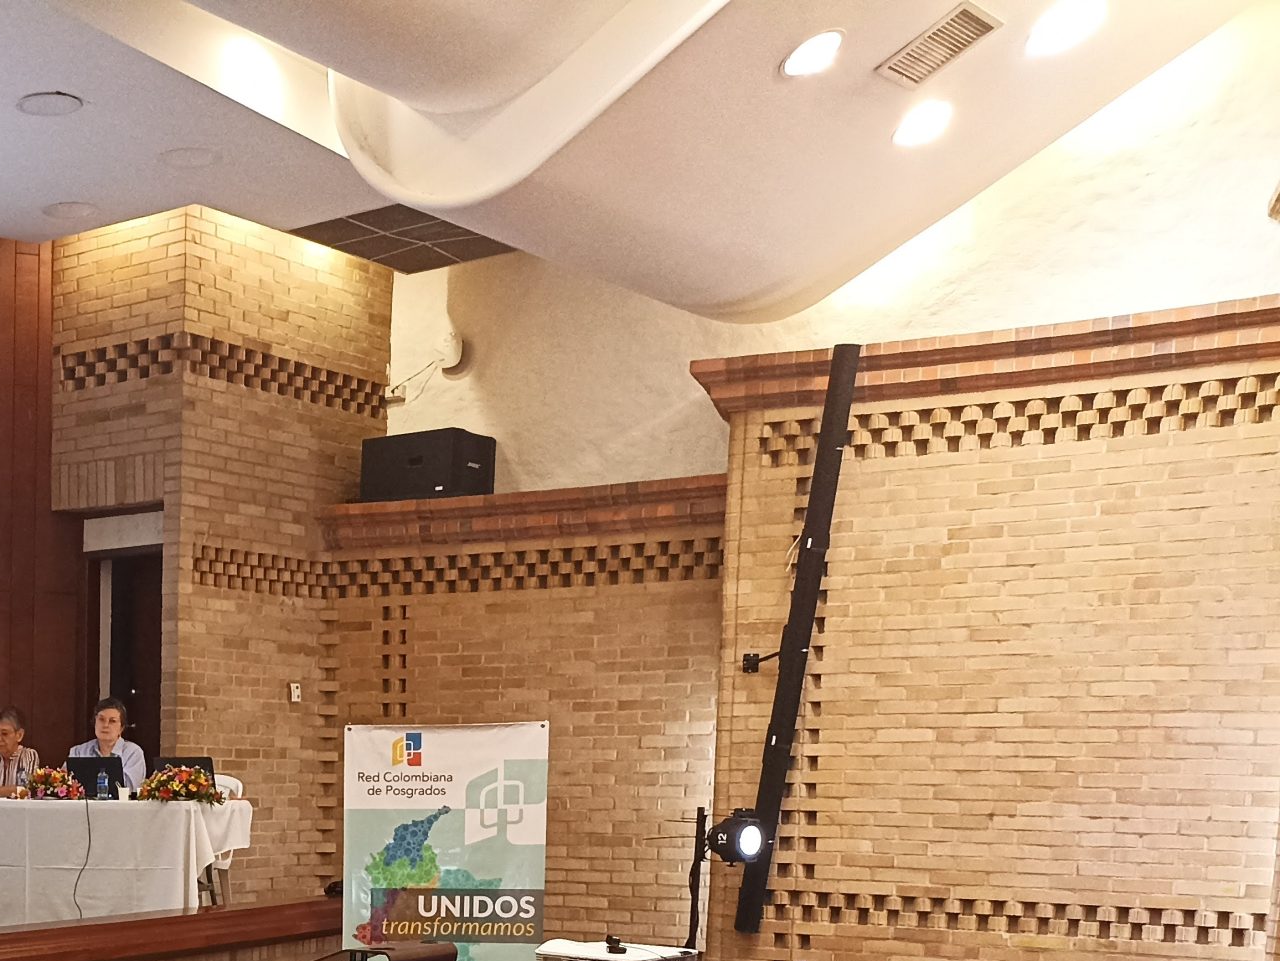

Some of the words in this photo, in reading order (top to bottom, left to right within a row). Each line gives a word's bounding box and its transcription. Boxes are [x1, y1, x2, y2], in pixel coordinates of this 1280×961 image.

[357, 772, 380, 783] Red
[383, 771, 453, 783] Colombiana
[367, 785, 382, 796] de
[385, 785, 447, 798] Posgrados
[418, 895, 535, 918] UNIDOS
[382, 917, 535, 937] transformamos
